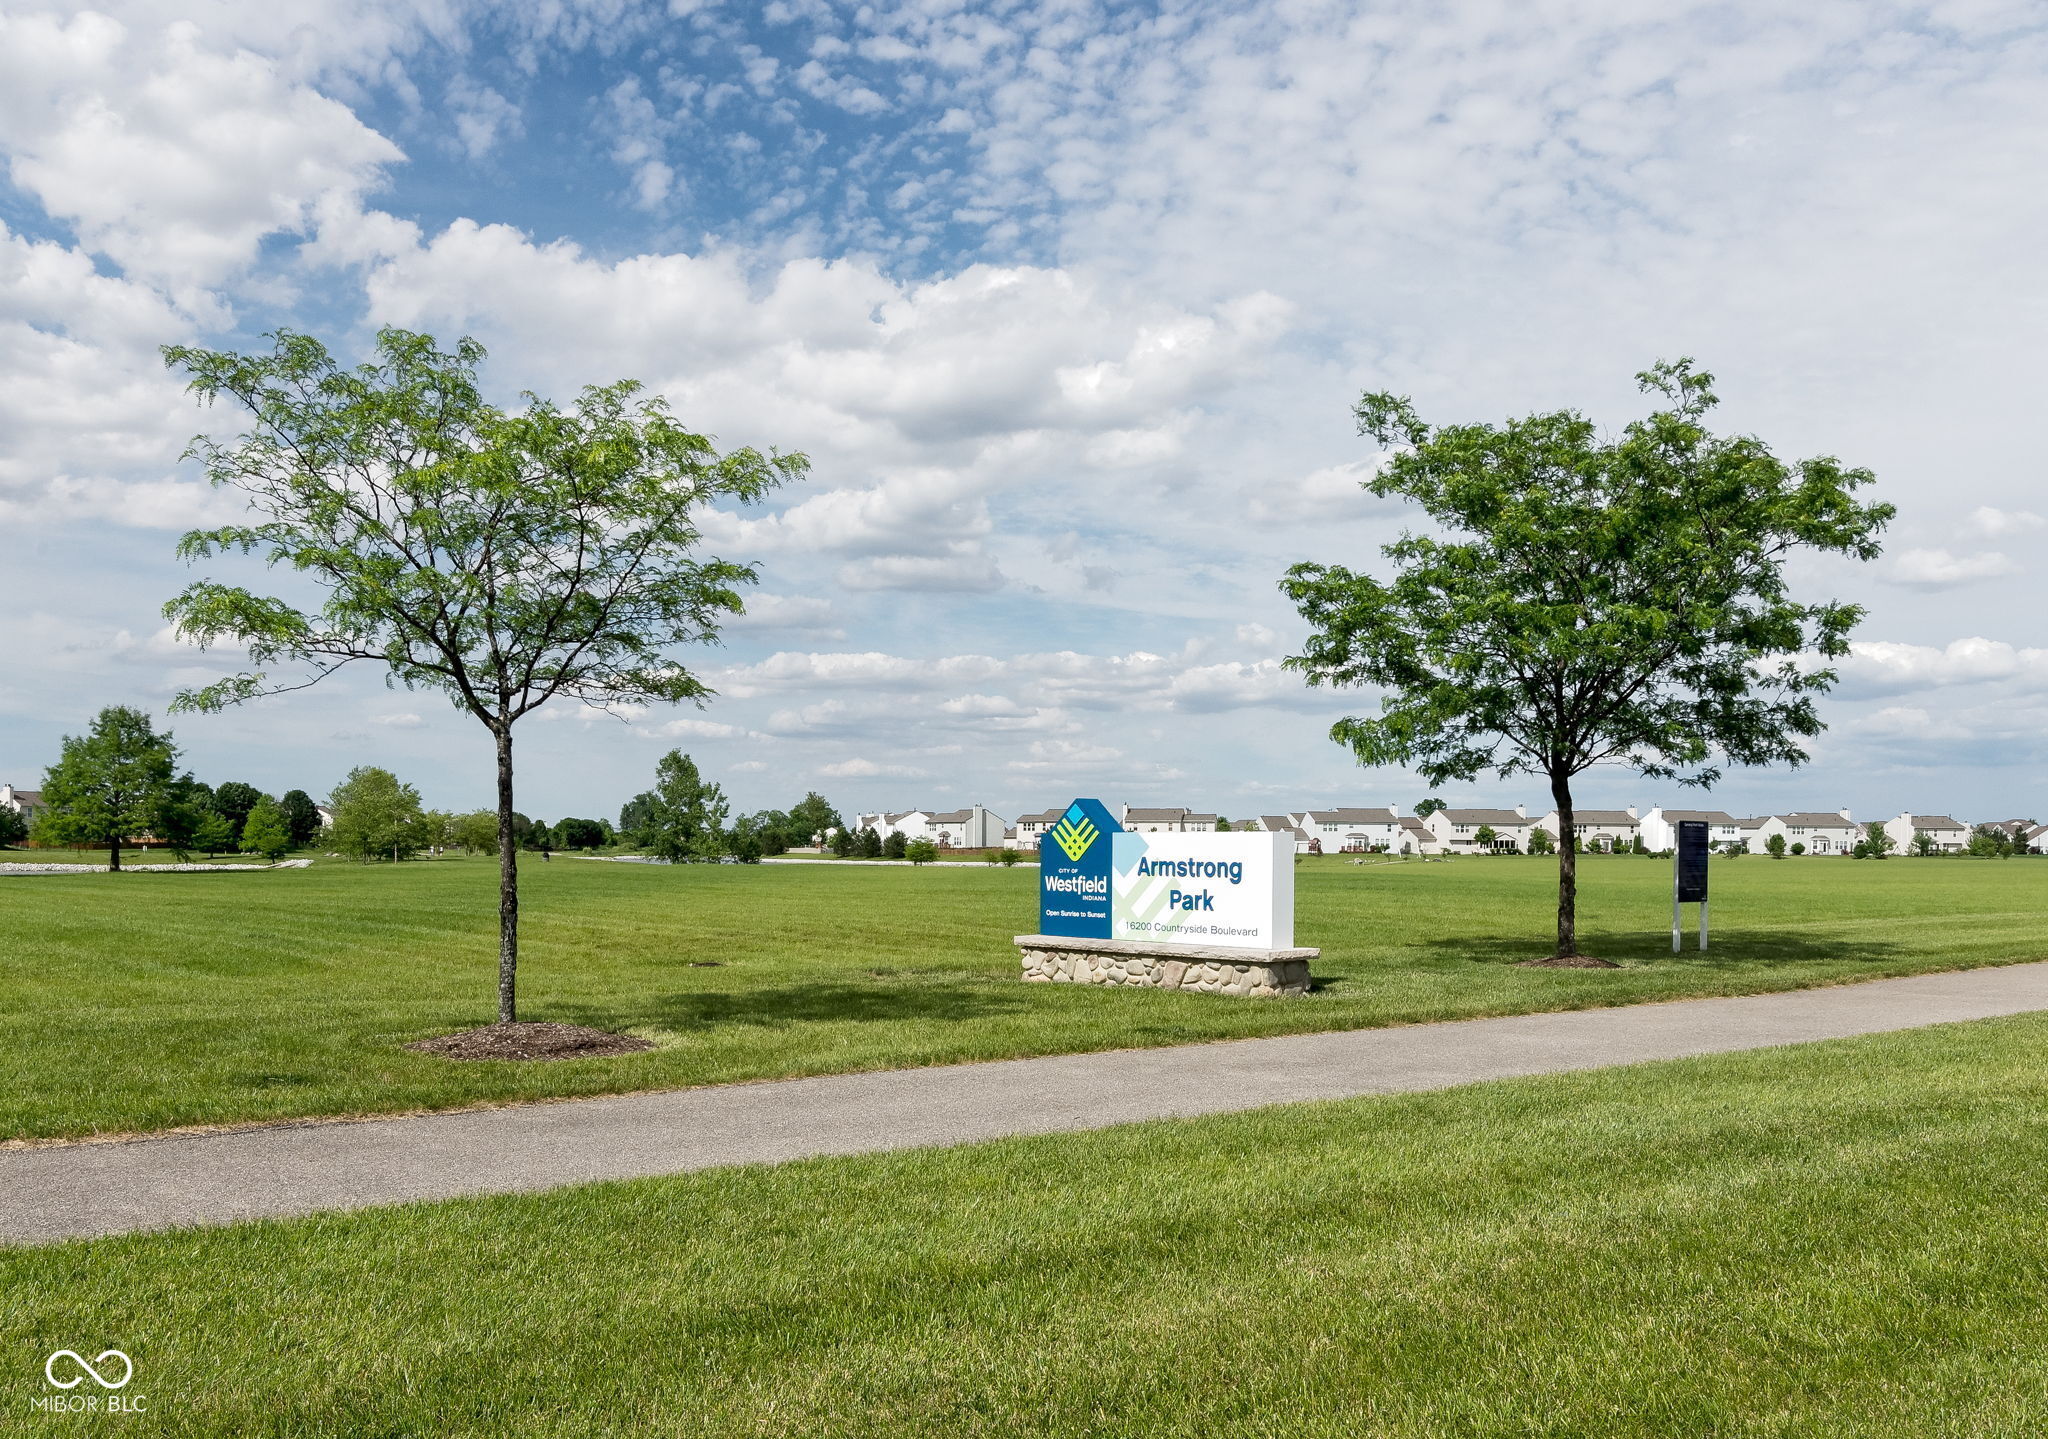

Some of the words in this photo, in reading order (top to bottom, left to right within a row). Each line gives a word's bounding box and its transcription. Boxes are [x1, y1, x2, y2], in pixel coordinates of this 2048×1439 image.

[1138, 856, 1243, 884] Armstrong
[1045, 875, 1107, 895] Westfield
[1170, 889, 1214, 911] Park
[1126, 921, 1152, 931] 16200
[1154, 922, 1208, 935] Countryside
[1211, 925, 1258, 937] Boulevard
